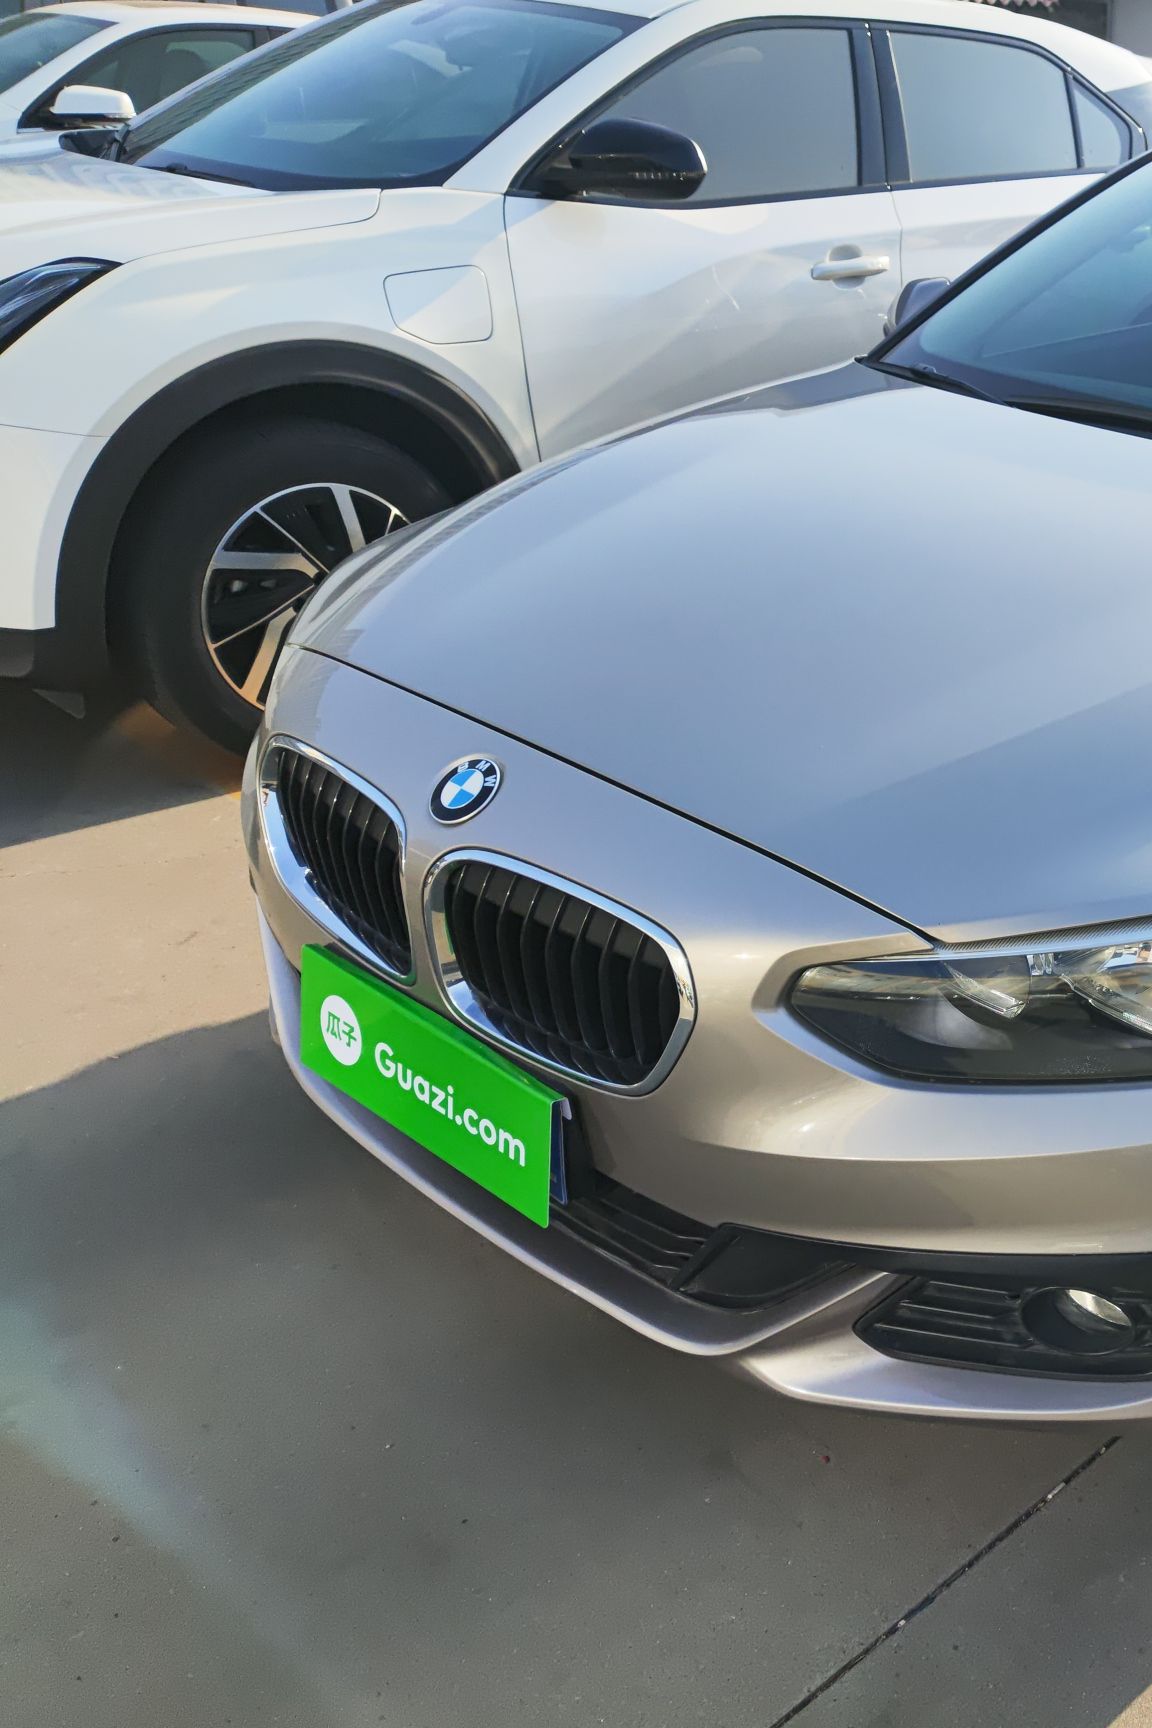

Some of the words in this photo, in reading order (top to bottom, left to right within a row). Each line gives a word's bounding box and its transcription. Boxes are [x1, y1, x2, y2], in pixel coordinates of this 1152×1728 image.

[457, 759, 497, 787] BMW
[326, 1011, 357, 1047] 瓜子
[374, 1042, 526, 1167] Guazi.com
